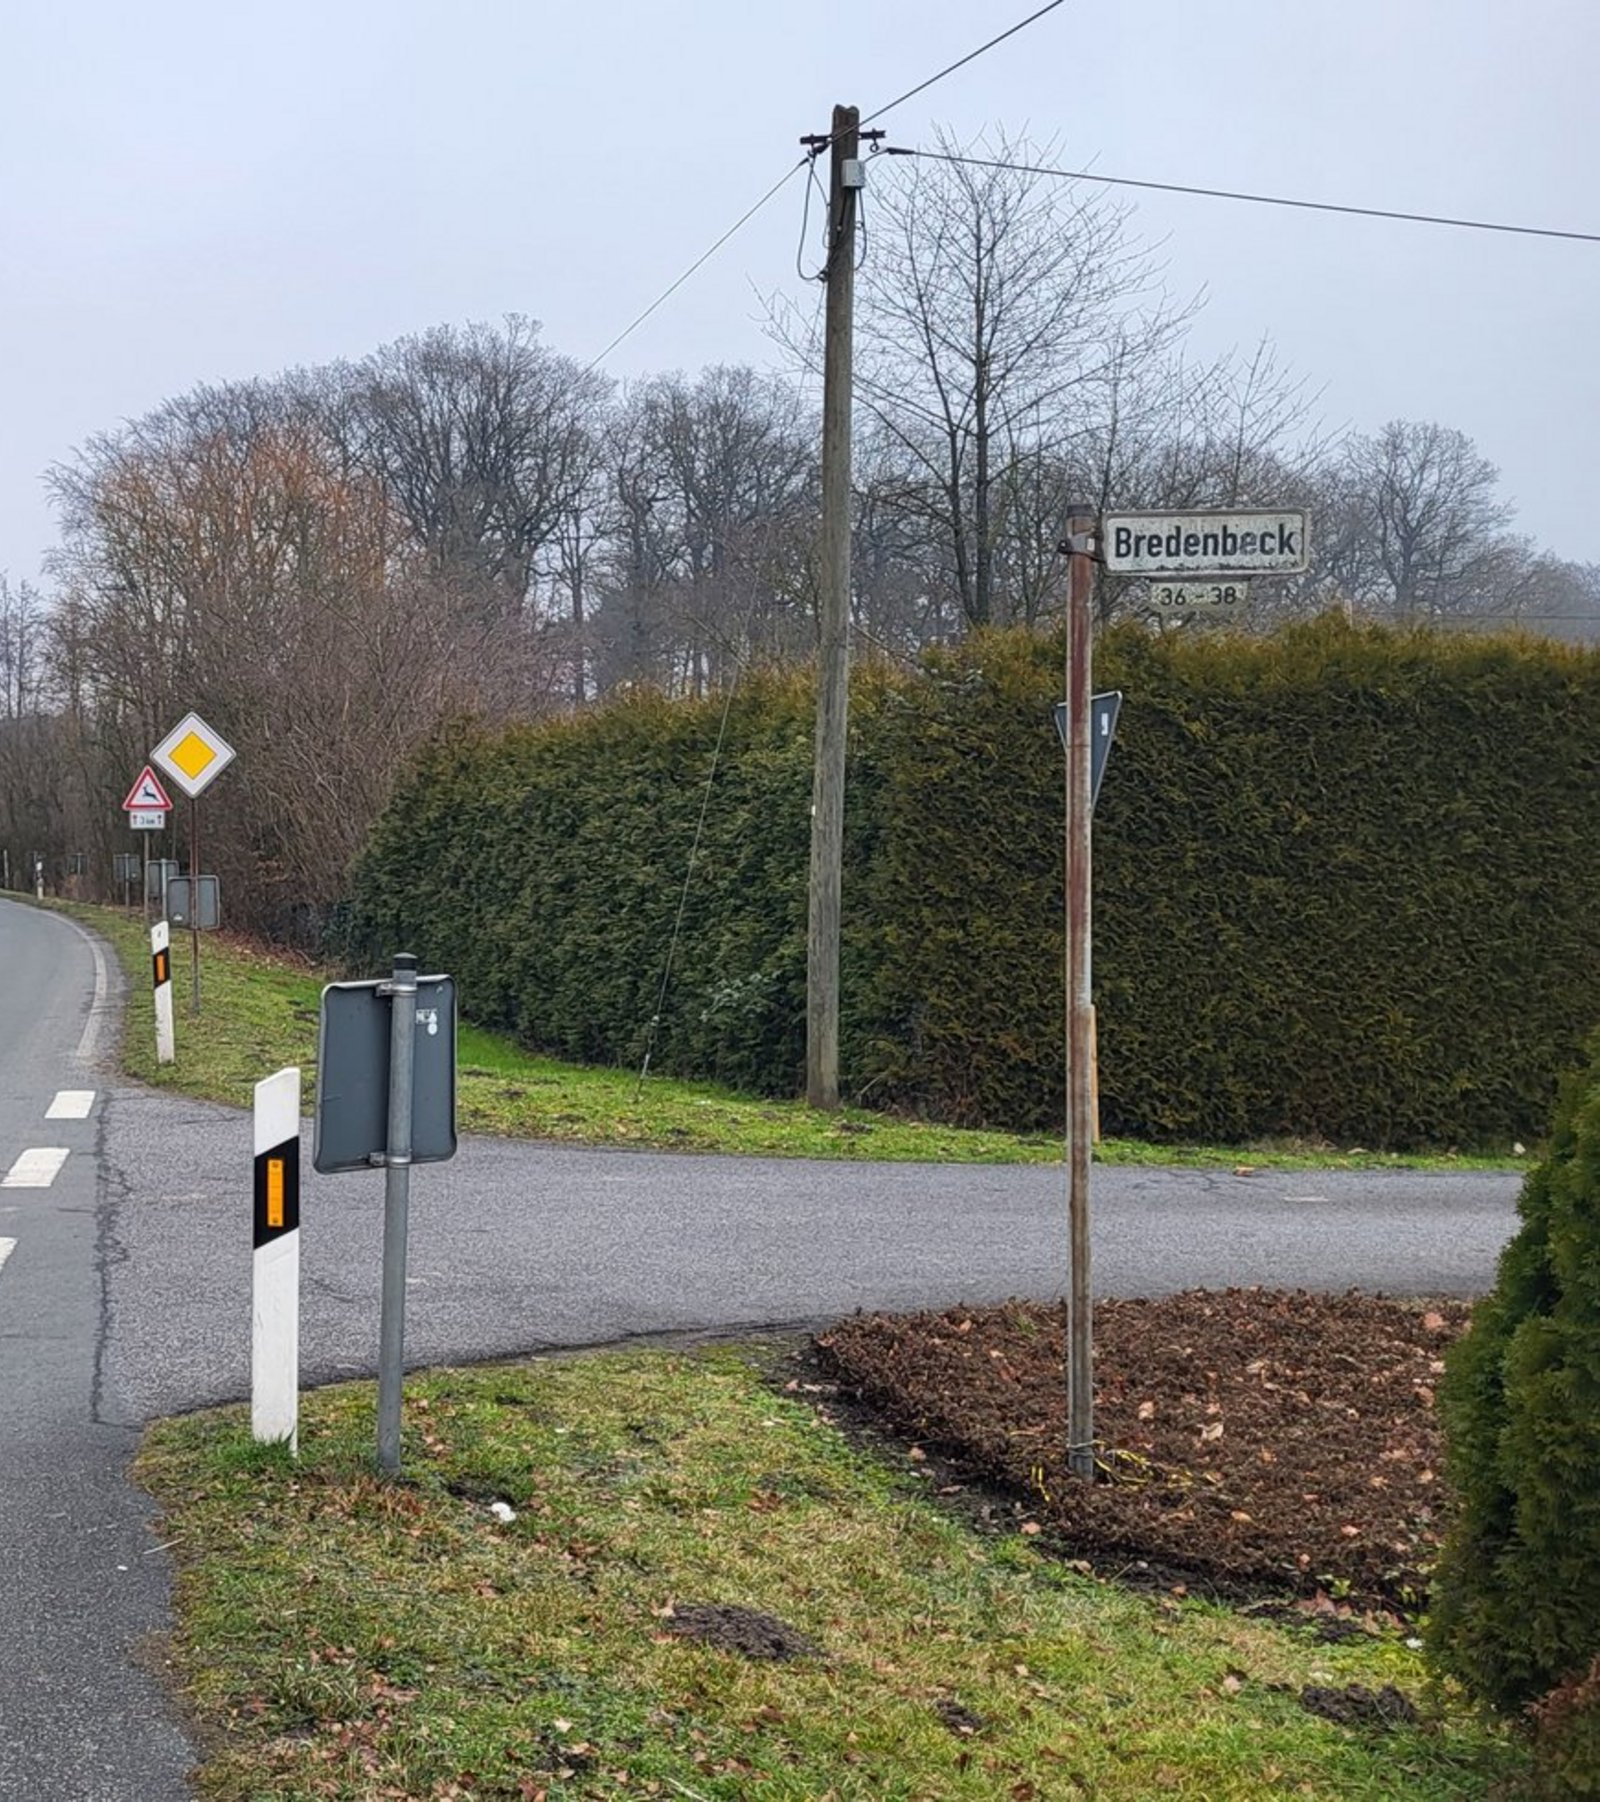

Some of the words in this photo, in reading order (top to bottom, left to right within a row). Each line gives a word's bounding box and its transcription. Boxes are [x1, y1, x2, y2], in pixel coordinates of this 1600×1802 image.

[1115, 524, 1296, 558] Bredenbeck
[1160, 587, 1187, 606] 36
[1209, 586, 1237, 606] 38
